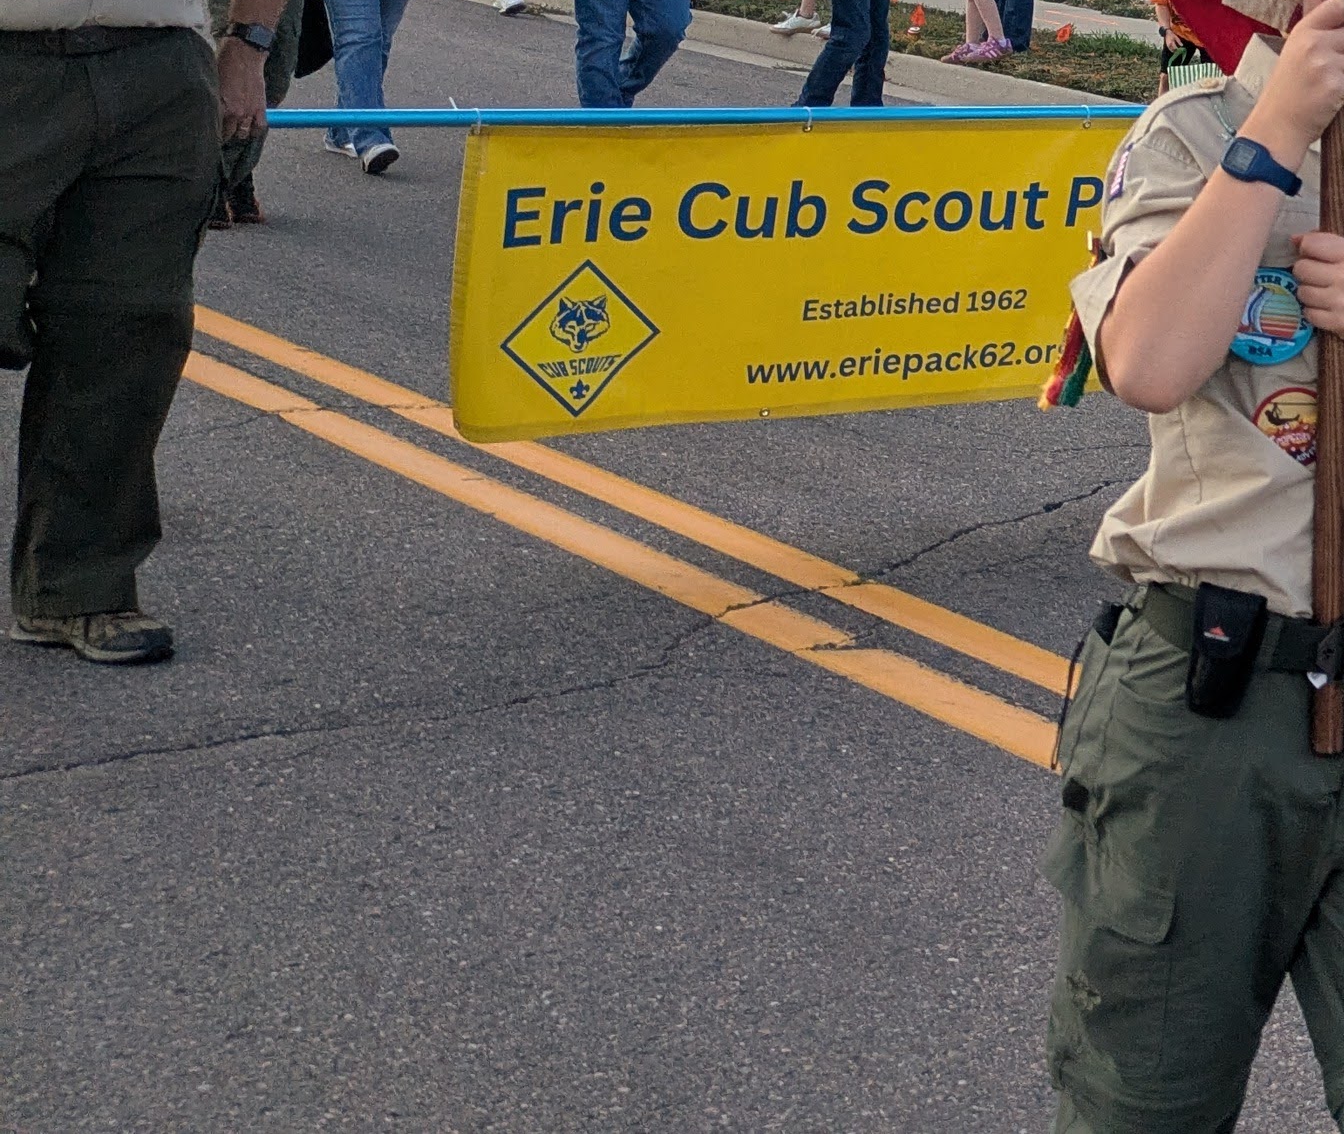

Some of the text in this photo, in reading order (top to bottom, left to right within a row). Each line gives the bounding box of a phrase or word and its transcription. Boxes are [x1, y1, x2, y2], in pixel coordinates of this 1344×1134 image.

[502, 181, 652, 249] Erie
[678, 180, 827, 240] Cub
[847, 179, 1049, 235] Scout
[802, 288, 1028, 321] Established 1962
[537, 353, 622, 378] CUB SCOUTS
